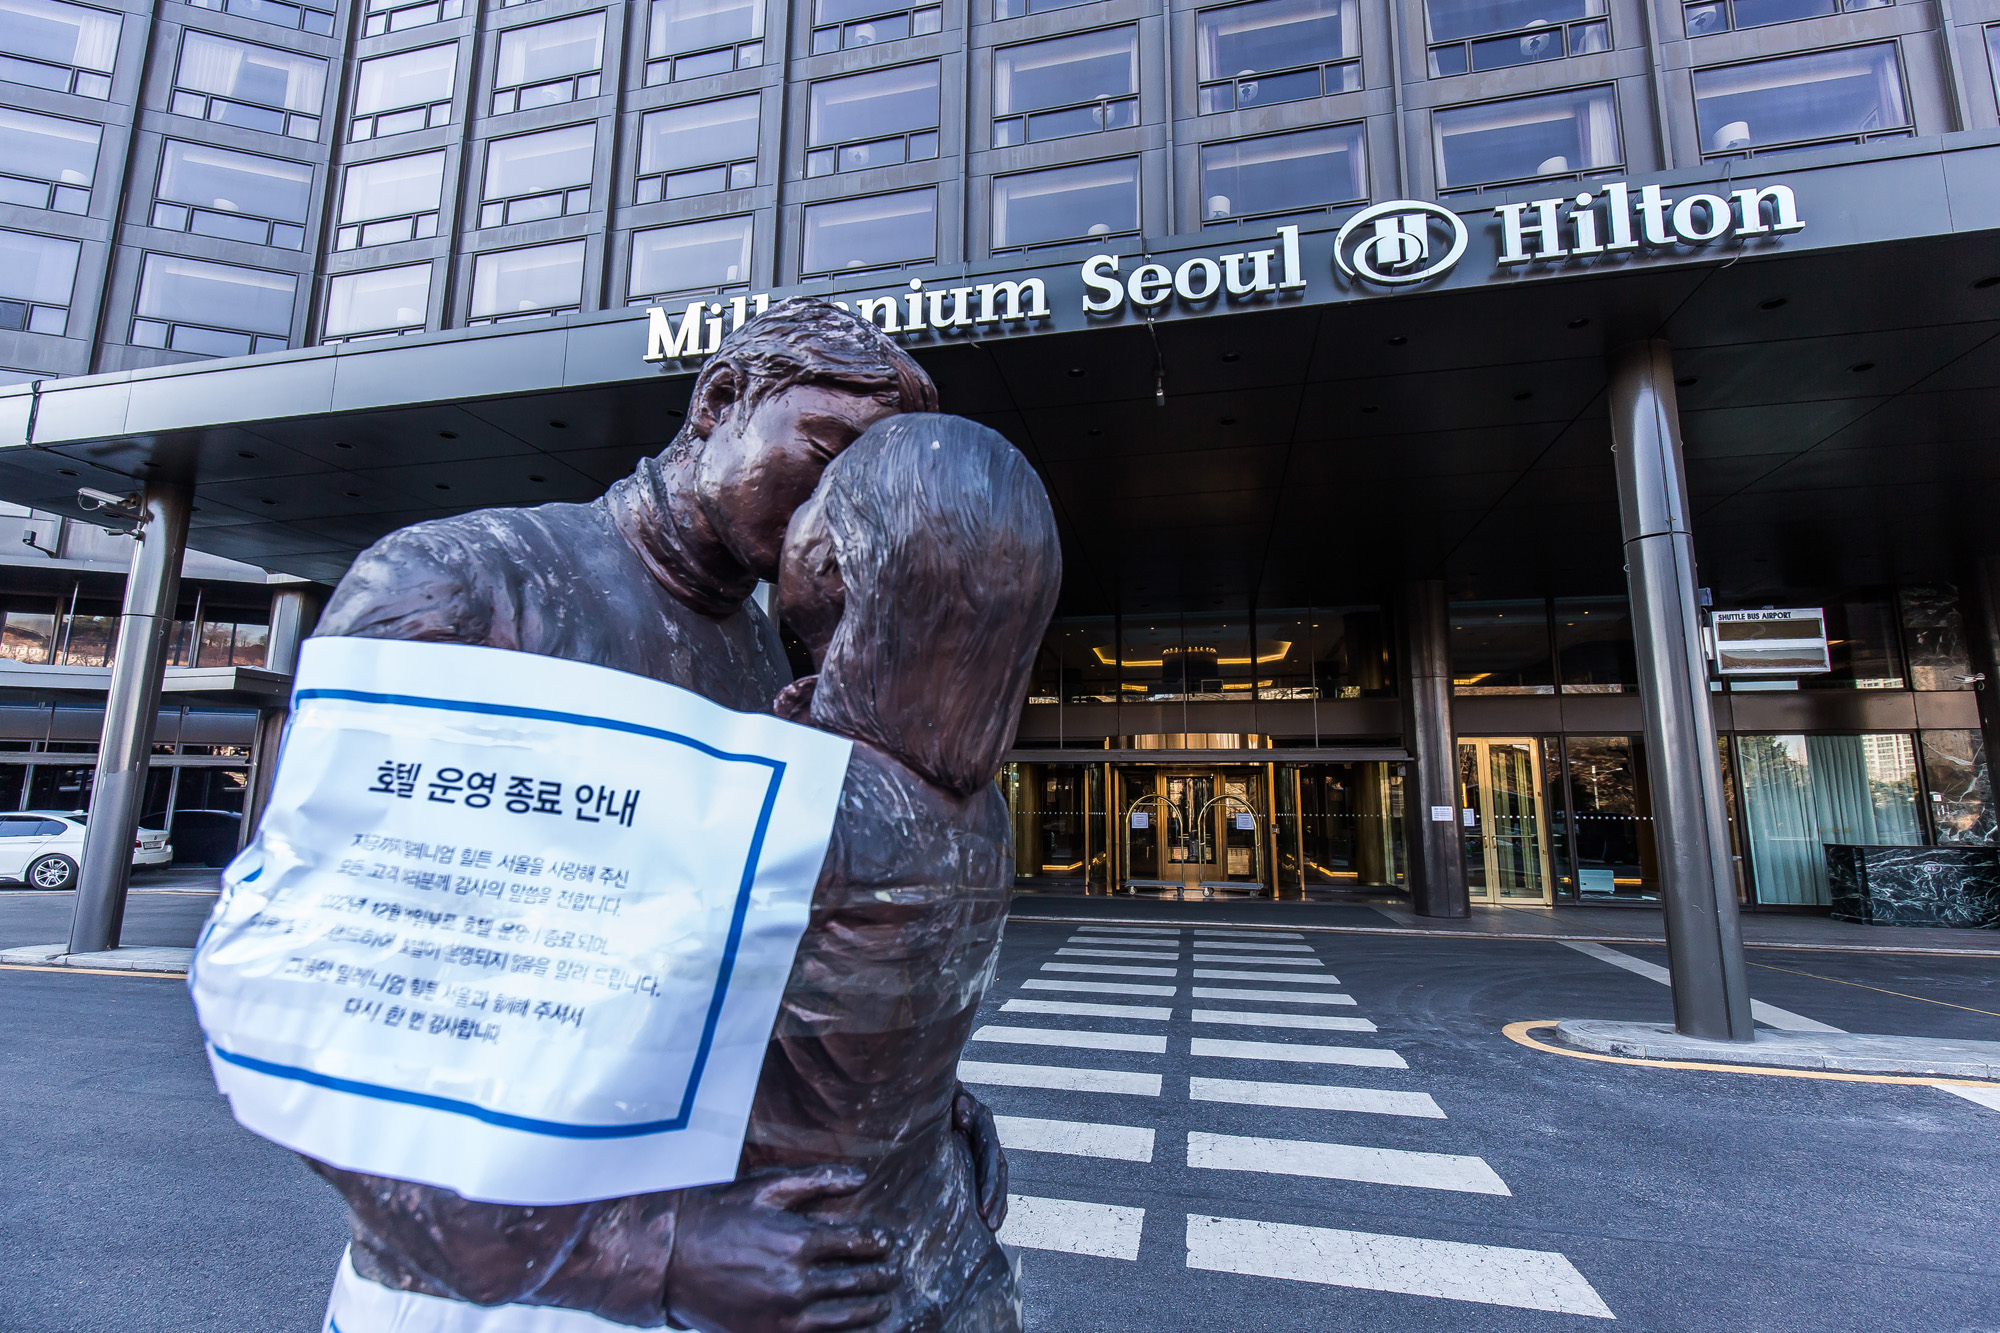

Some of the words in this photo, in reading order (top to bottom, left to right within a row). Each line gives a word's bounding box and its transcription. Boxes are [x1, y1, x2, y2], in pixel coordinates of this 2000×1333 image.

[643, 277, 1051, 362] Milnium
[1080, 224, 1306, 314] Seoul
[1493, 182, 1806, 267] Hilton
[1718, 613, 1745, 621] SHUTTLE
[1747, 612, 1760, 620] BUS
[1762, 611, 1791, 619] AIRPORT
[367, 760, 422, 799] 호텔
[427, 766, 497, 809] 운영
[504, 774, 563, 815] 종료
[574, 784, 641, 828] 안내
[460, 847, 493, 869] 힐튼
[496, 854, 545, 876] 서울을
[547, 861, 597, 883] 사랑해
[598, 866, 630, 889] 주신
[366, 862, 401, 883] 고객
[455, 876, 507, 900] 감사의
[509, 883, 552, 905] 말씀을
[556, 890, 622, 917] 전합니다.
[460, 915, 495, 938] 호텔
[335, 964, 407, 996] 밀레니엄
[444, 944, 510, 971] 운영되지
[510, 953, 551, 978] 않음을
[591, 967, 661, 998] 드립니다.
[384, 1005, 407, 1027] 한
[408, 1010, 428, 1031] 번
